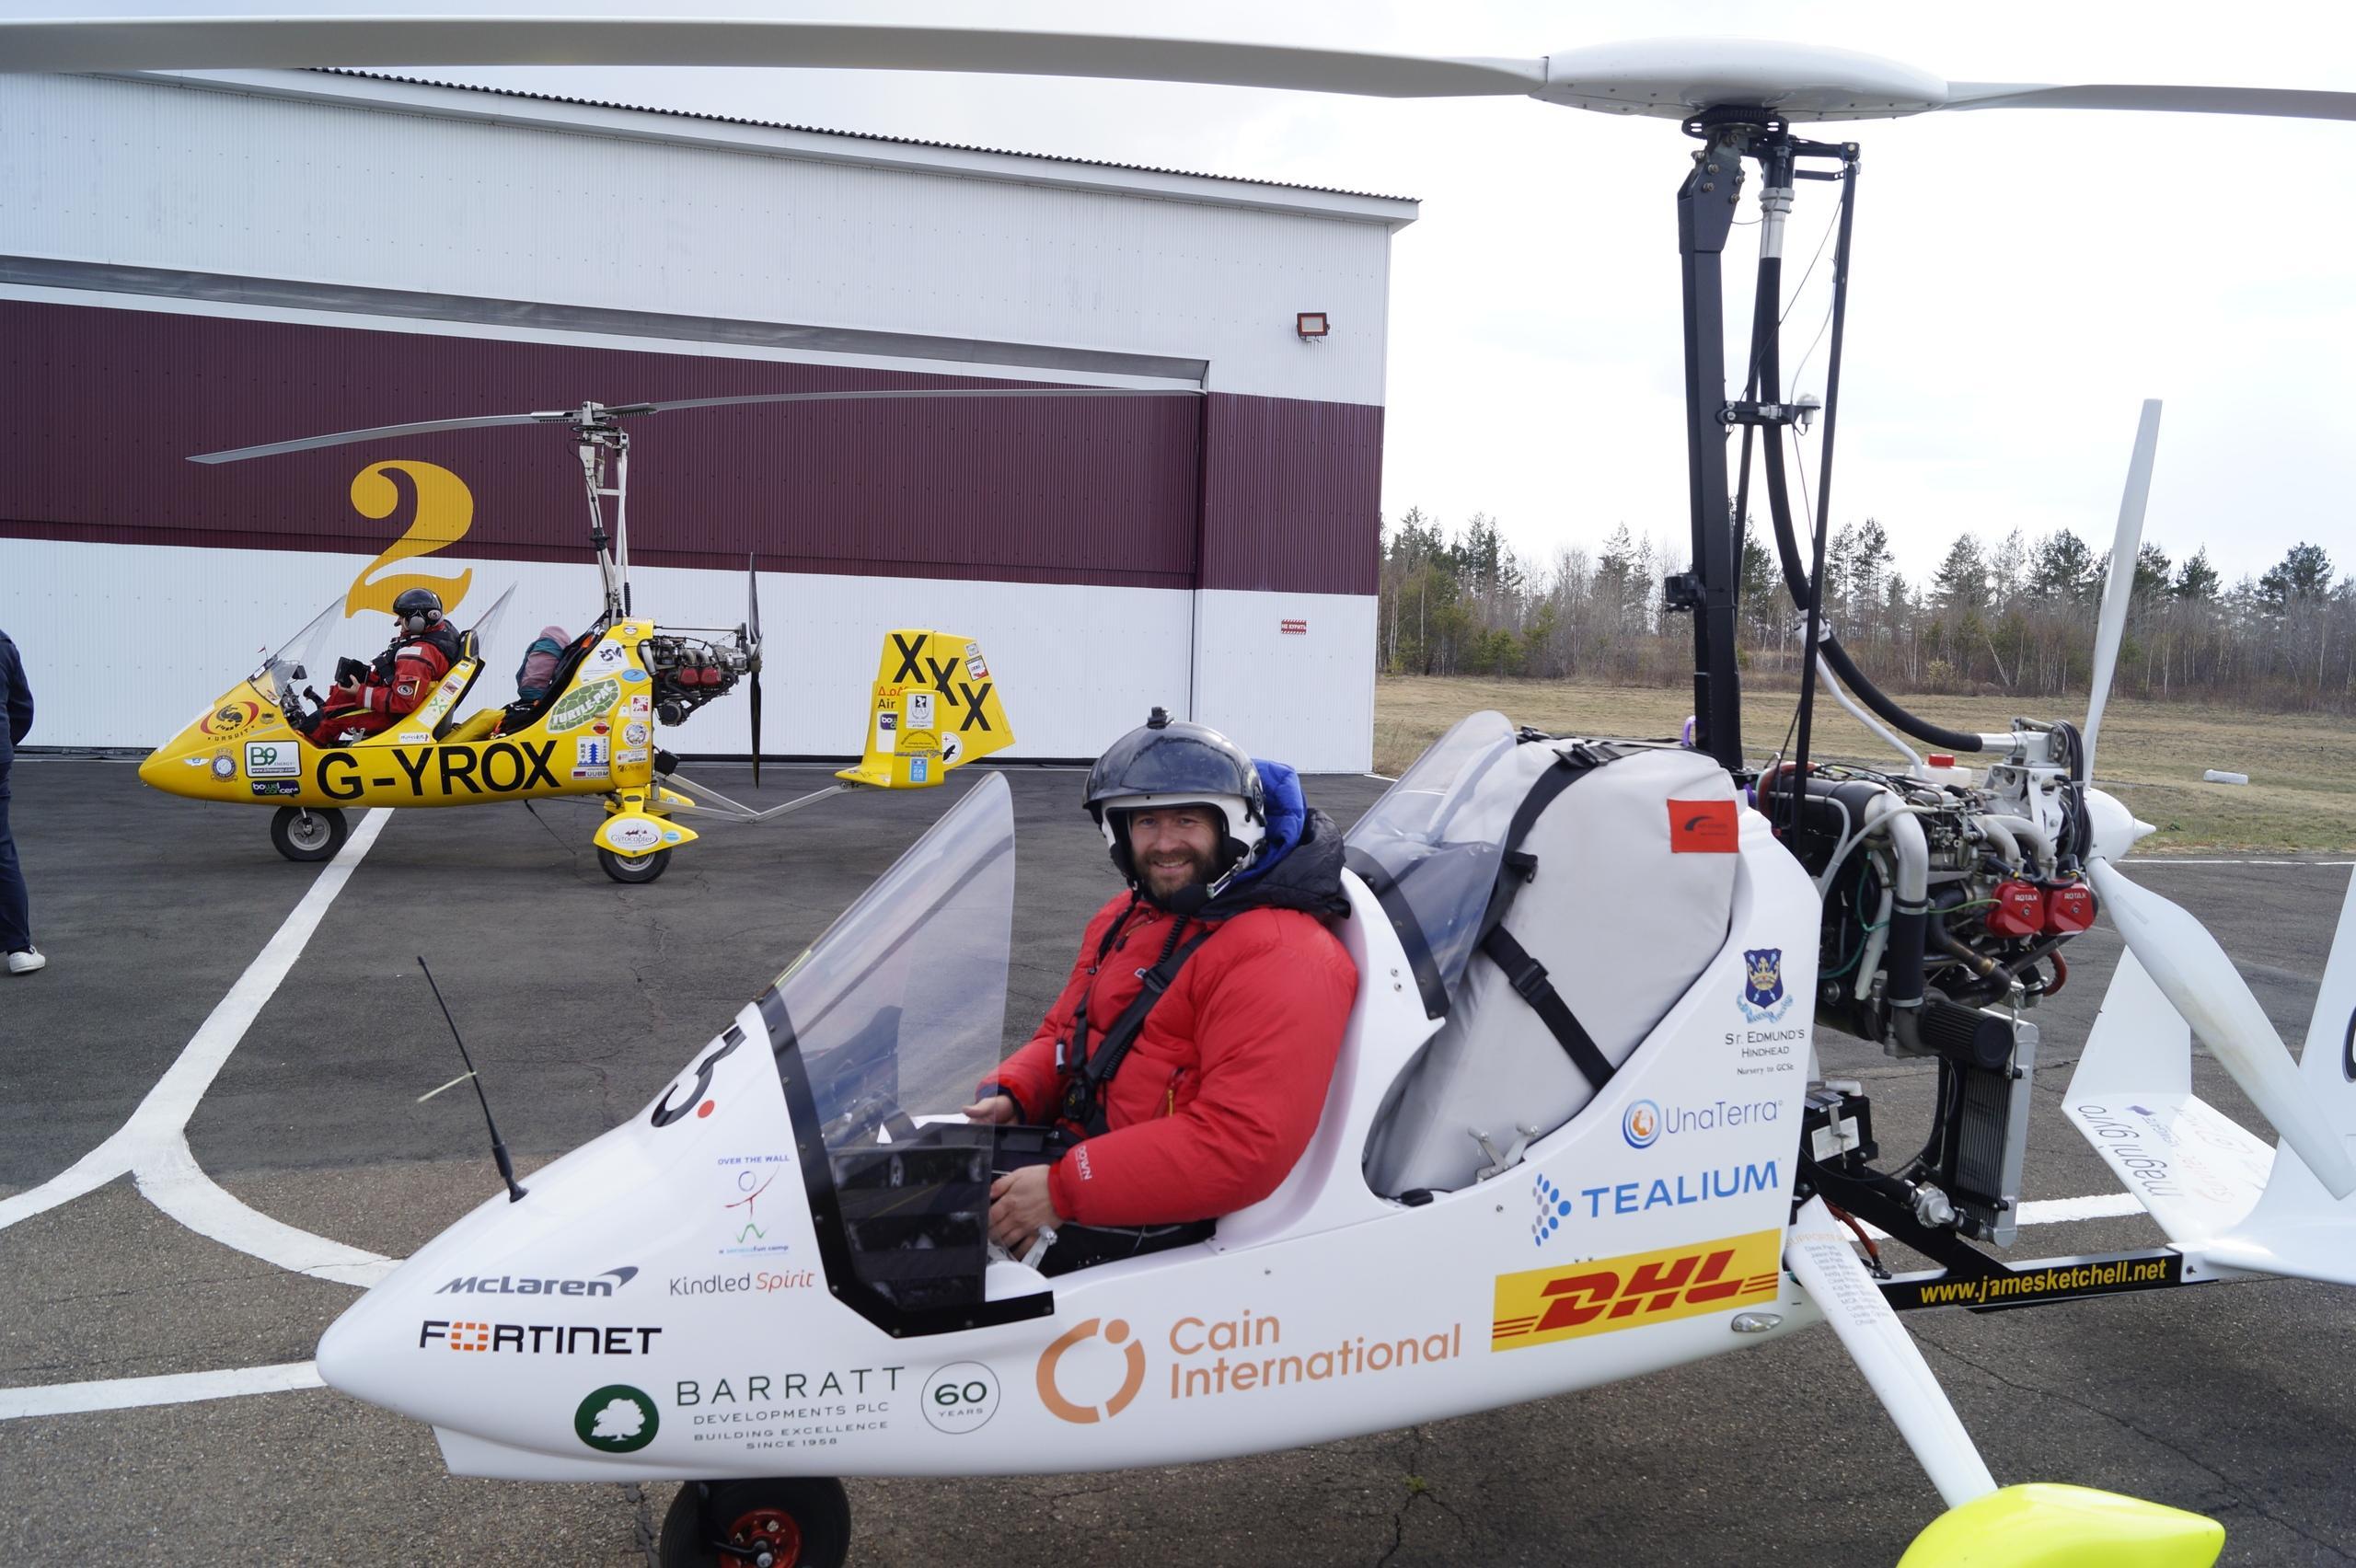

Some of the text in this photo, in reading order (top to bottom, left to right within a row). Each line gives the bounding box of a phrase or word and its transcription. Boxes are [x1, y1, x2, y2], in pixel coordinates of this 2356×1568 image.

[345, 460, 473, 618] 2
[877, 698, 895, 709] Air
[250, 746, 277, 767] B9
[317, 740, 561, 801] G-YROX
[610, 834, 653, 844] Gyrocopter
[2015, 894, 2038, 902] ROTAX
[2063, 892, 2087, 900] ROTAX
[1737, 1066, 1764, 1076] Nursery
[718, 1154, 791, 1166] OVER THE WALL
[1078, 1144, 1093, 1181] DOWN
[1581, 1160, 1778, 1218] TEALIUM
[433, 1275, 613, 1297] McLaren
[669, 1269, 815, 1297] Kindled Spirit
[1533, 1249, 1745, 1332] DHL
[1920, 1258, 2167, 1304] www.jamesketchell.net
[419, 1320, 663, 1355] FORTINET
[1169, 1309, 1281, 1356] Cain
[1170, 1323, 1461, 1400] International
[676, 1366, 906, 1407] BARRATT
[934, 1380, 988, 1407] 60
[693, 1401, 890, 1426] DEVELOPMENTS PLC
[938, 1407, 984, 1418] YEARS
[693, 1420, 889, 1442] BUILDING EXCELLENCE
[745, 1437, 838, 1450] SINCE 1958
